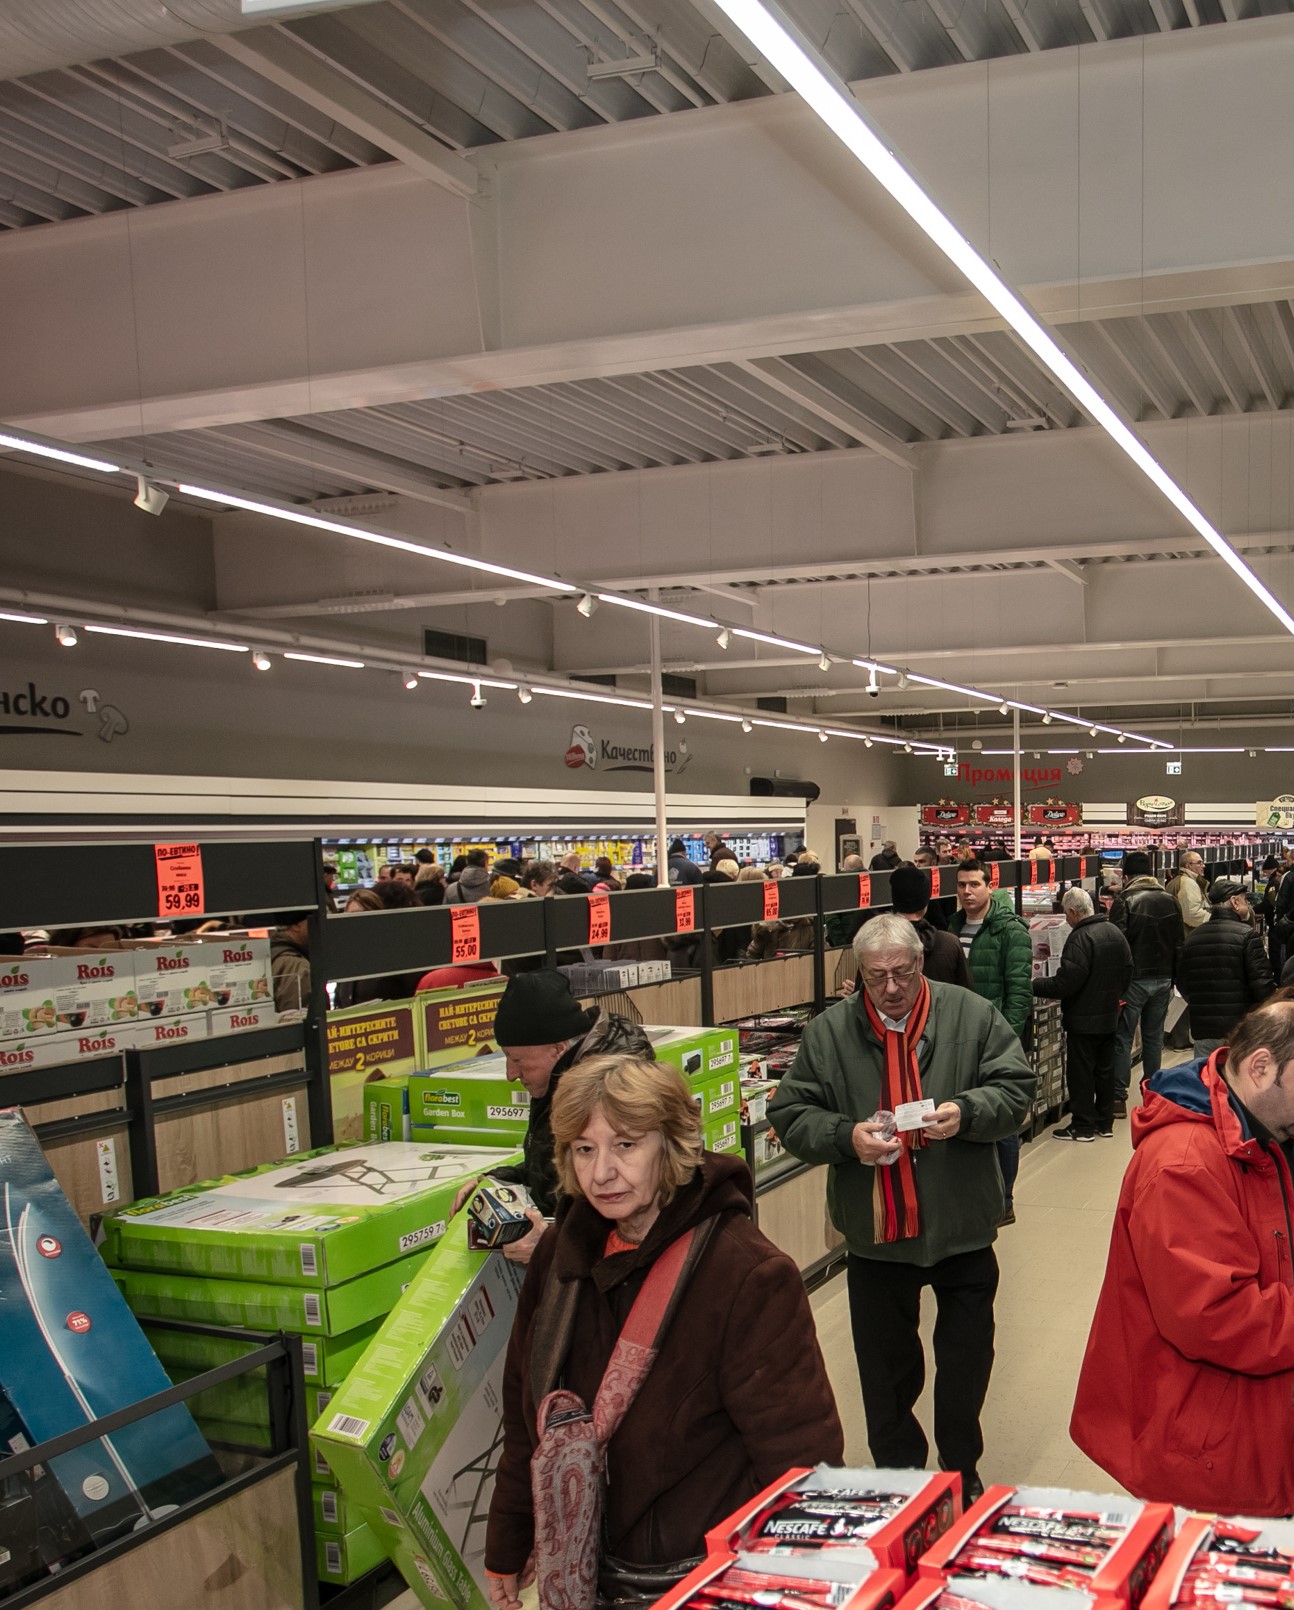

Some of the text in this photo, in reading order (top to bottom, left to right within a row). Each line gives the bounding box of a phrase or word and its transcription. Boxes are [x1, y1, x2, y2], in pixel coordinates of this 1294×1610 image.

[957, 763, 1062, 788] Промция
[157, 845, 200, 857] ПО-ЕВТИНО!
[165, 893, 200, 910] 59,99
[223, 949, 253, 963] Rois
[455, 944, 477, 958] 55,00
[156, 956, 190, 971] Rois
[0, 972, 29, 987] ois
[77, 964, 115, 980] Rois
[230, 1014, 259, 1028] Rois
[327, 1016, 397, 1040] АЙ-ИНТЕРЕСНИТЕ
[438, 1018, 469, 1031] СВЕТОВЕ
[469, 1016, 478, 1025] СА
[155, 1025, 188, 1040] Rois
[444, 1034, 468, 1045] МЕЖДУ
[468, 1029, 477, 1046] 2
[79, 1036, 116, 1053] Rois
[328, 1030, 399, 1054] ЕТОВЕ СА СКРИТИ
[355, 1052, 366, 1071] 2
[366, 1049, 395, 1063] КОРИЦИ
[424, 1090, 459, 1104] florabest
[423, 1107, 466, 1118] Garden Box
[489, 1106, 525, 1117] 295697
[381, 1105, 390, 1141] florabes
[126, 1195, 194, 1216] florabest
[402, 1224, 441, 1247] 295759 7
[72, 1317, 88, 1327] 71%
[411, 1501, 444, 1559] Aluminium
[764, 1518, 830, 1535] NESCAFÉ
